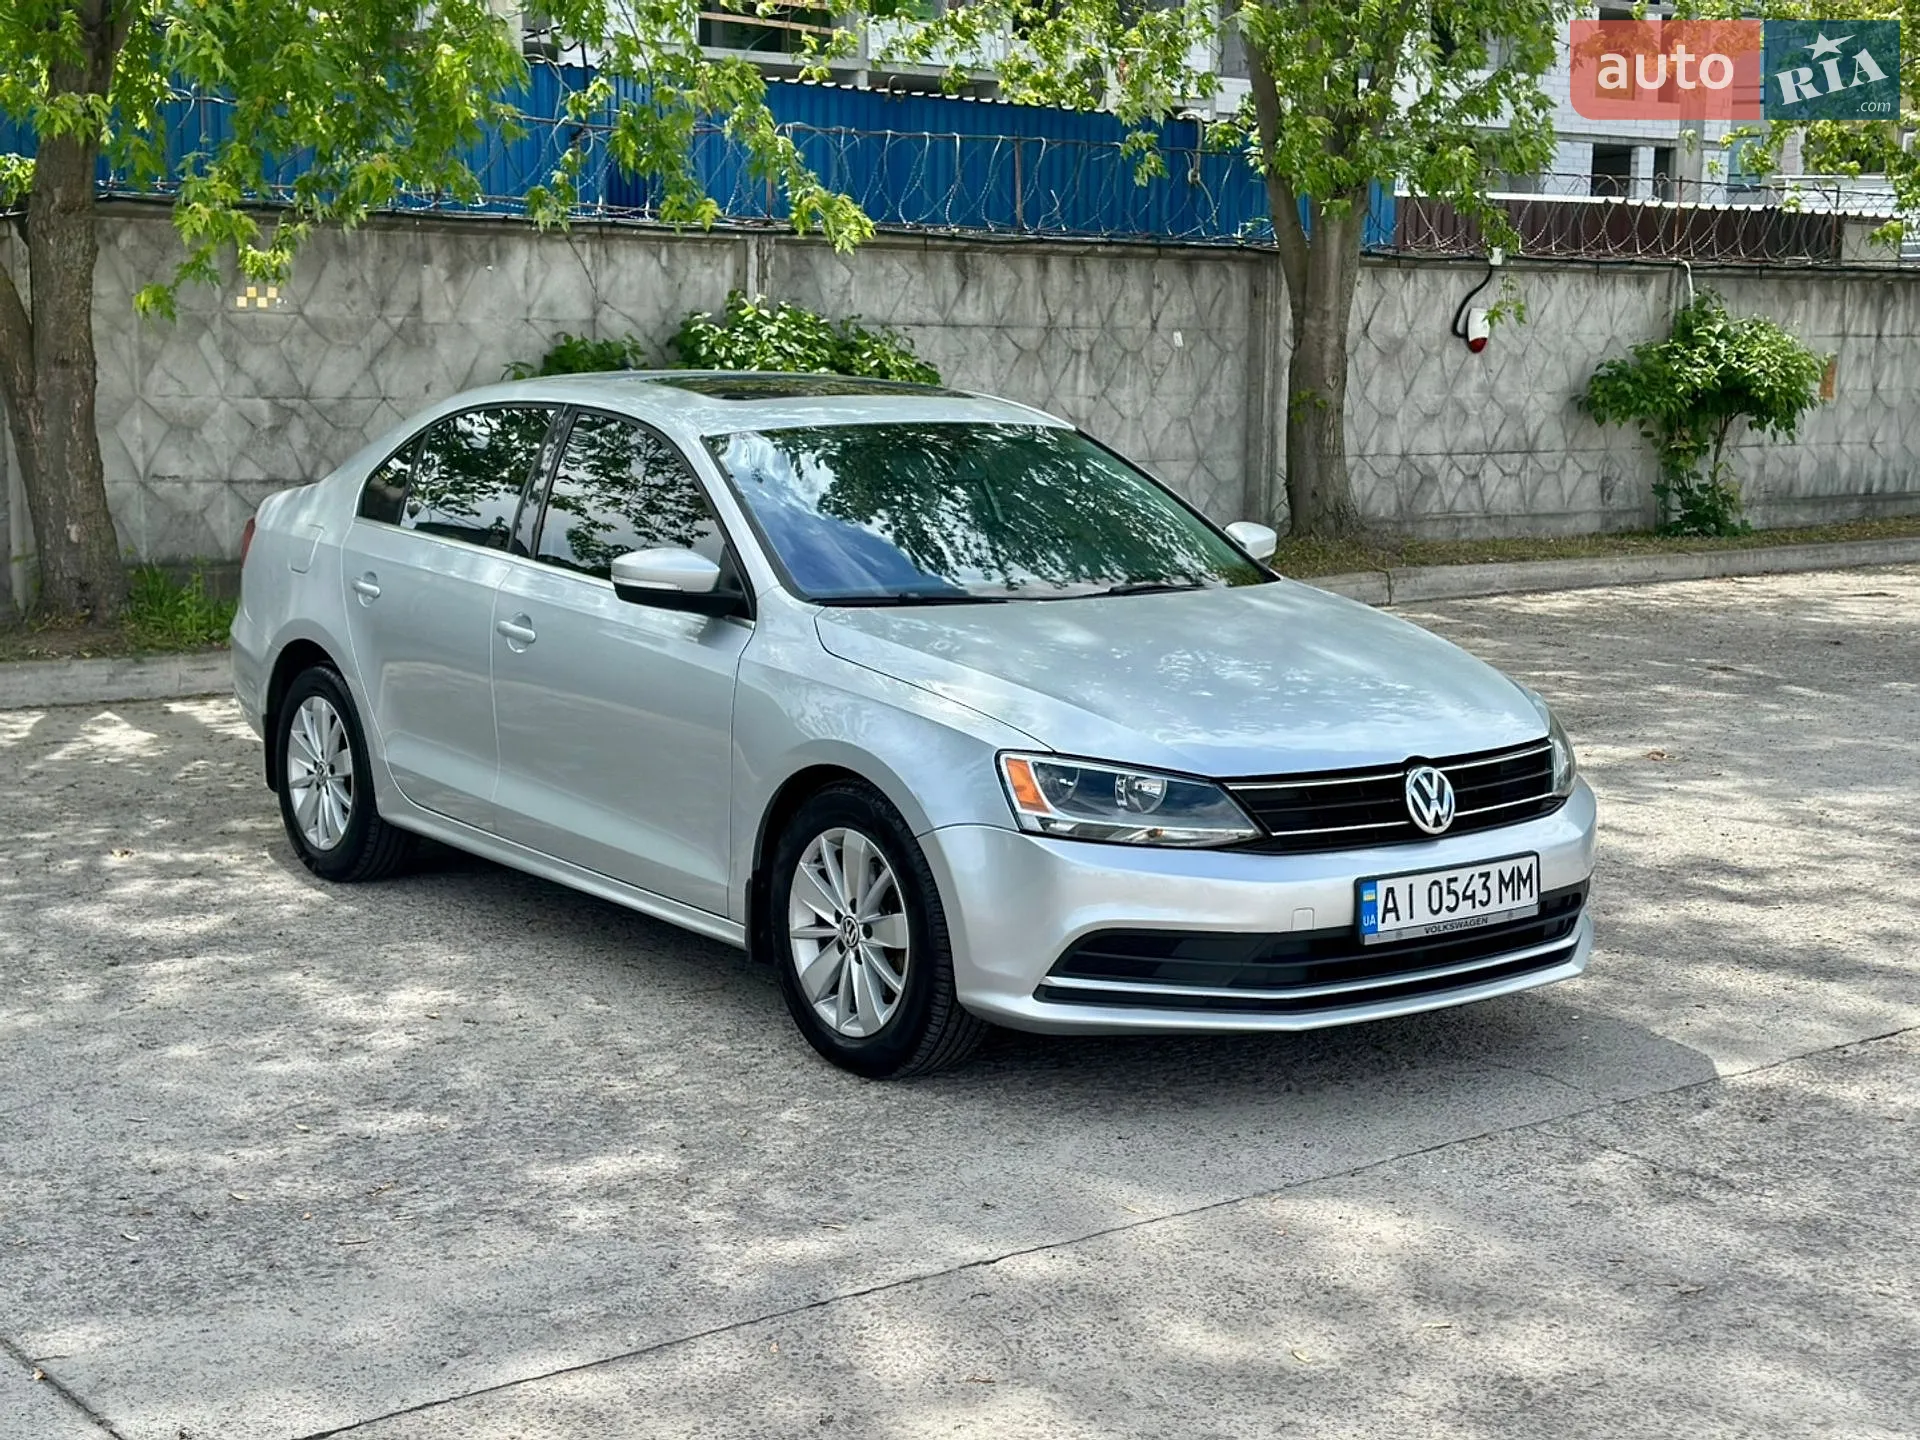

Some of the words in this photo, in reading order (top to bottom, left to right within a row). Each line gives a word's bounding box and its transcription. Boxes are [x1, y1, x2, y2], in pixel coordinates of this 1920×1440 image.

[1381, 883, 1415, 924] AI
[1427, 871, 1491, 916] 0543
[1498, 863, 1534, 904] MM
[1362, 915, 1377, 927] UA
[1424, 917, 1489, 934] VOLKSWAGEN
